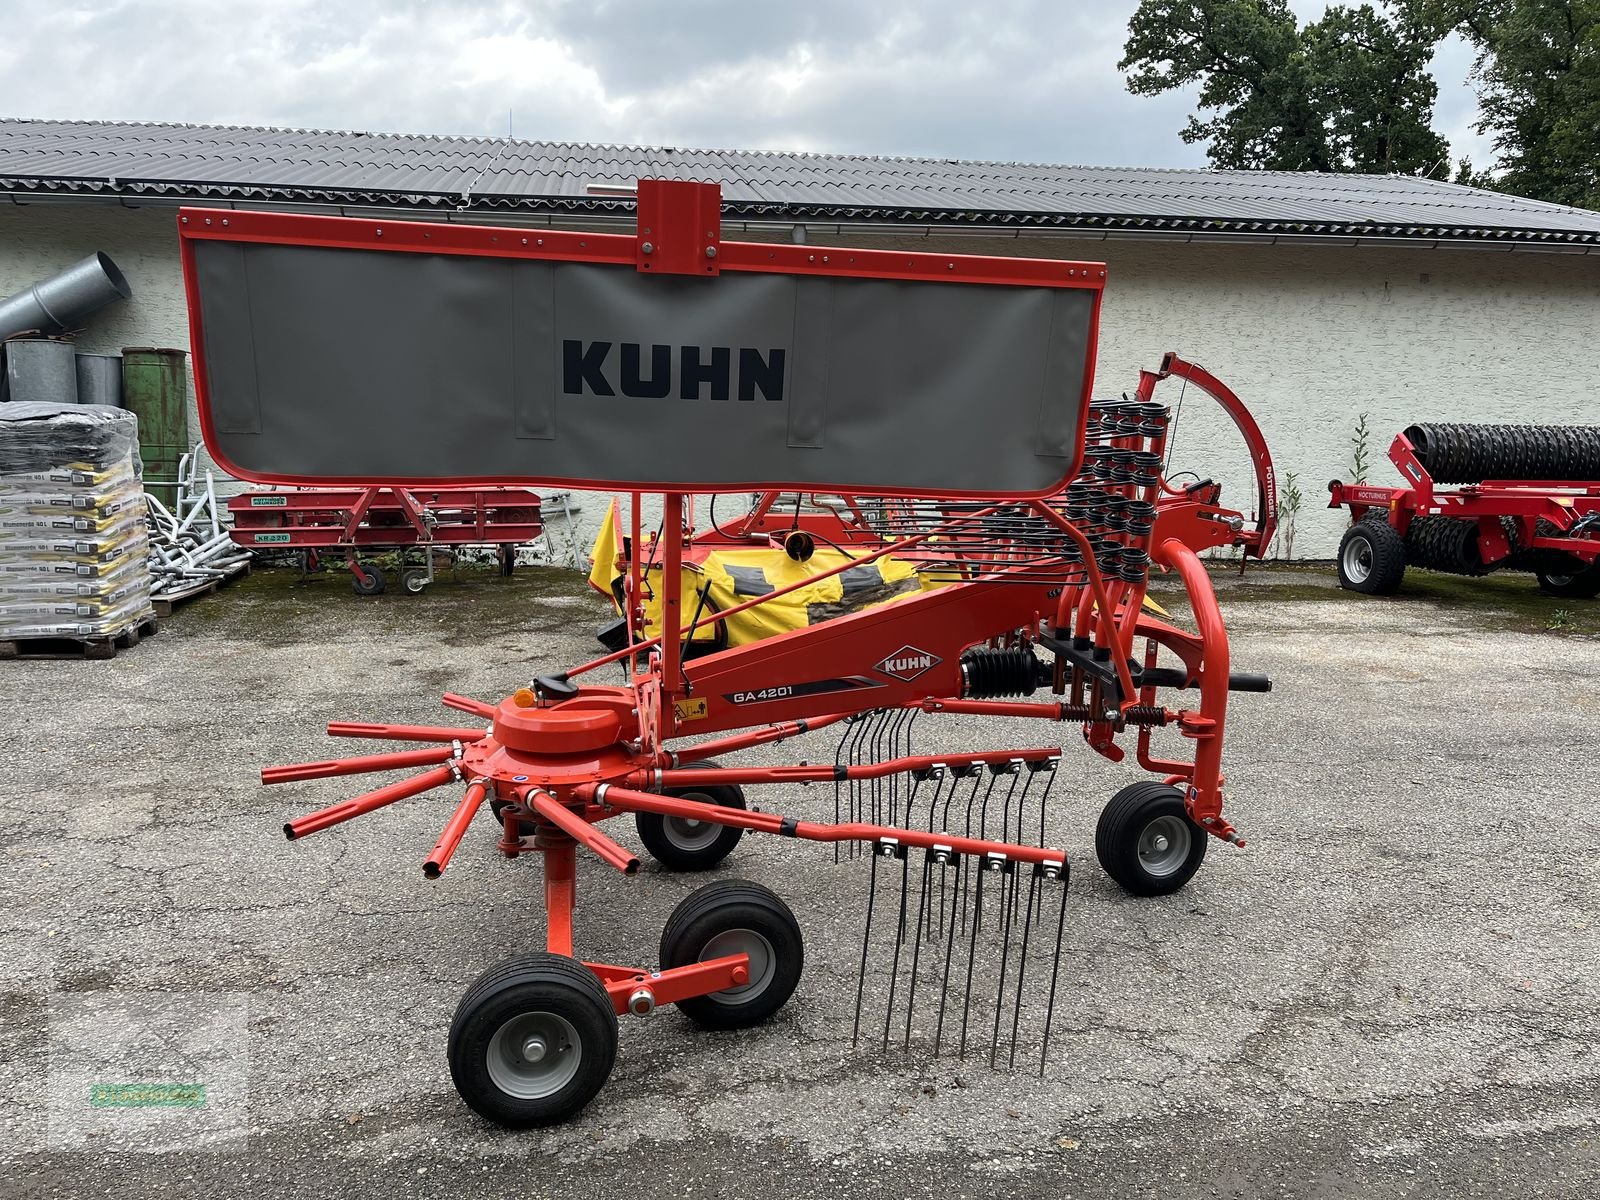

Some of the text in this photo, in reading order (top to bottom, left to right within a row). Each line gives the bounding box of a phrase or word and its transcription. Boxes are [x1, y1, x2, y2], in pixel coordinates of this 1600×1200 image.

[563, 340, 785, 401] KUHN
[1265, 466, 1274, 518] PÖTTINGER
[1358, 491, 1387, 500] NOCTURNUS
[884, 655, 931, 672] KUHN
[733, 686, 793, 703] GA 4201
